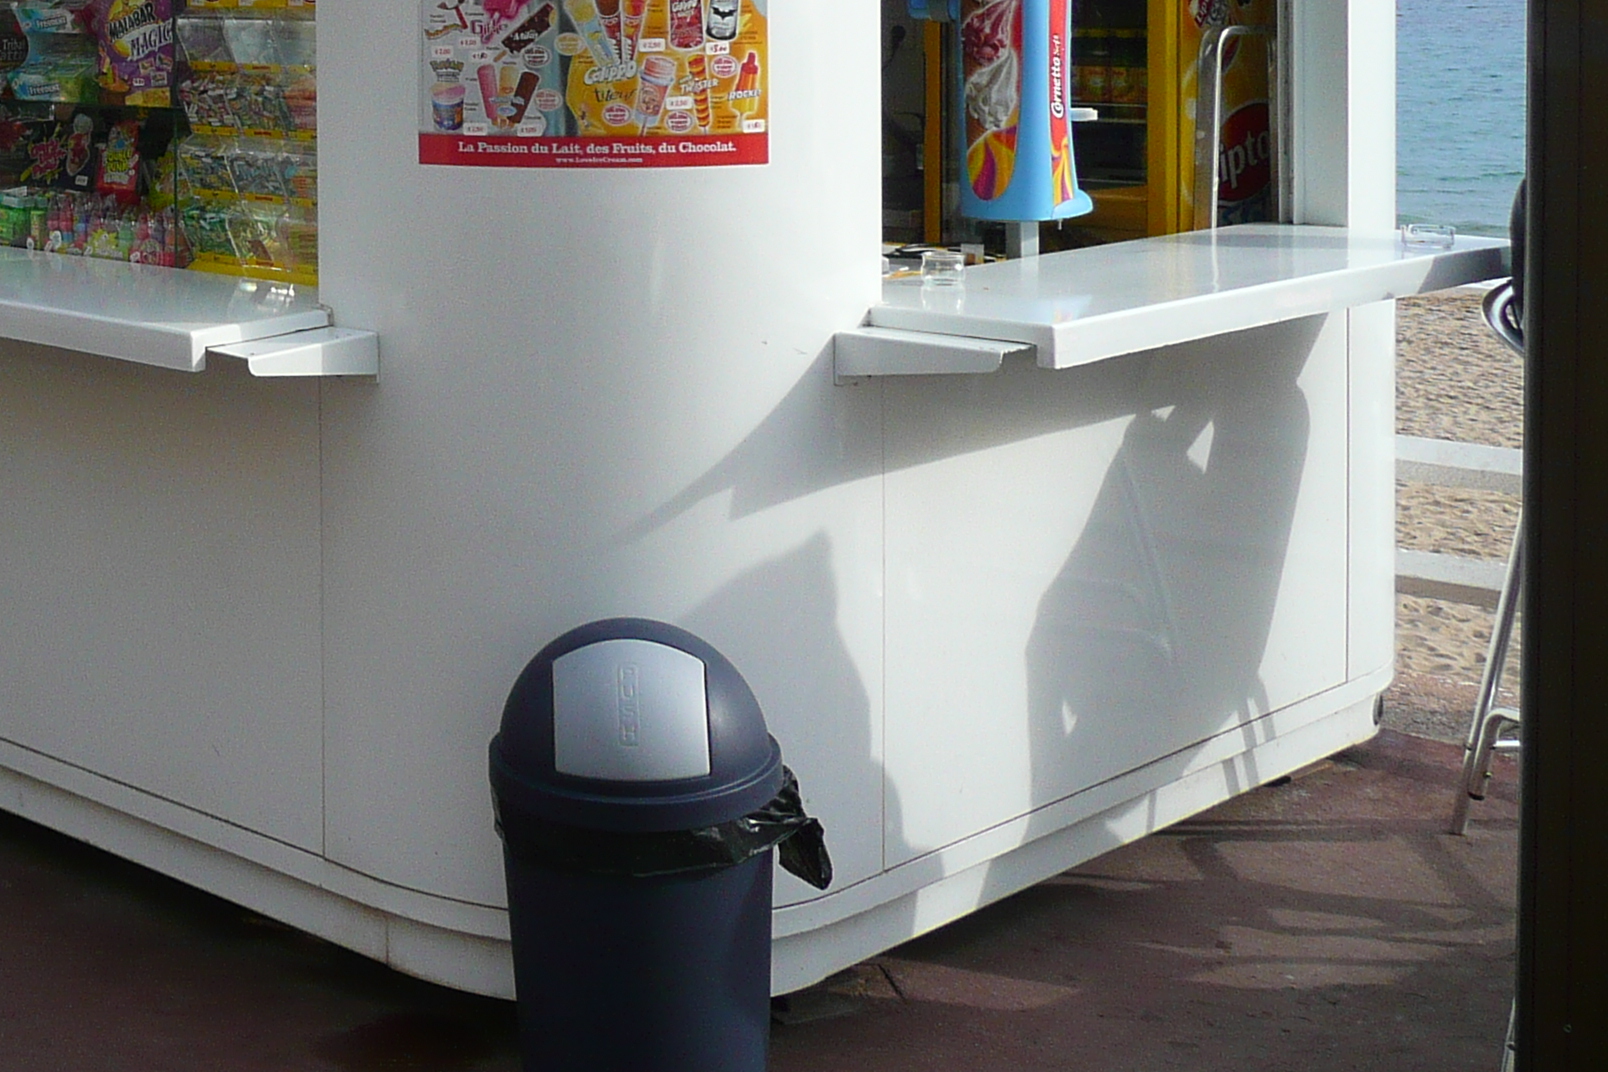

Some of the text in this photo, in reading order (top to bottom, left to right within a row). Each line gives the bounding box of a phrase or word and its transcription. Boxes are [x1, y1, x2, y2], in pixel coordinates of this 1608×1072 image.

[130, 17, 173, 57] MAGIC
[584, 61, 637, 86] Calippo
[1050, 57, 1065, 120] Cornetto
[458, 141, 737, 155] La Passion du Lait, des Fruits, du Chocolat.
[622, 665, 636, 742] PUSH
